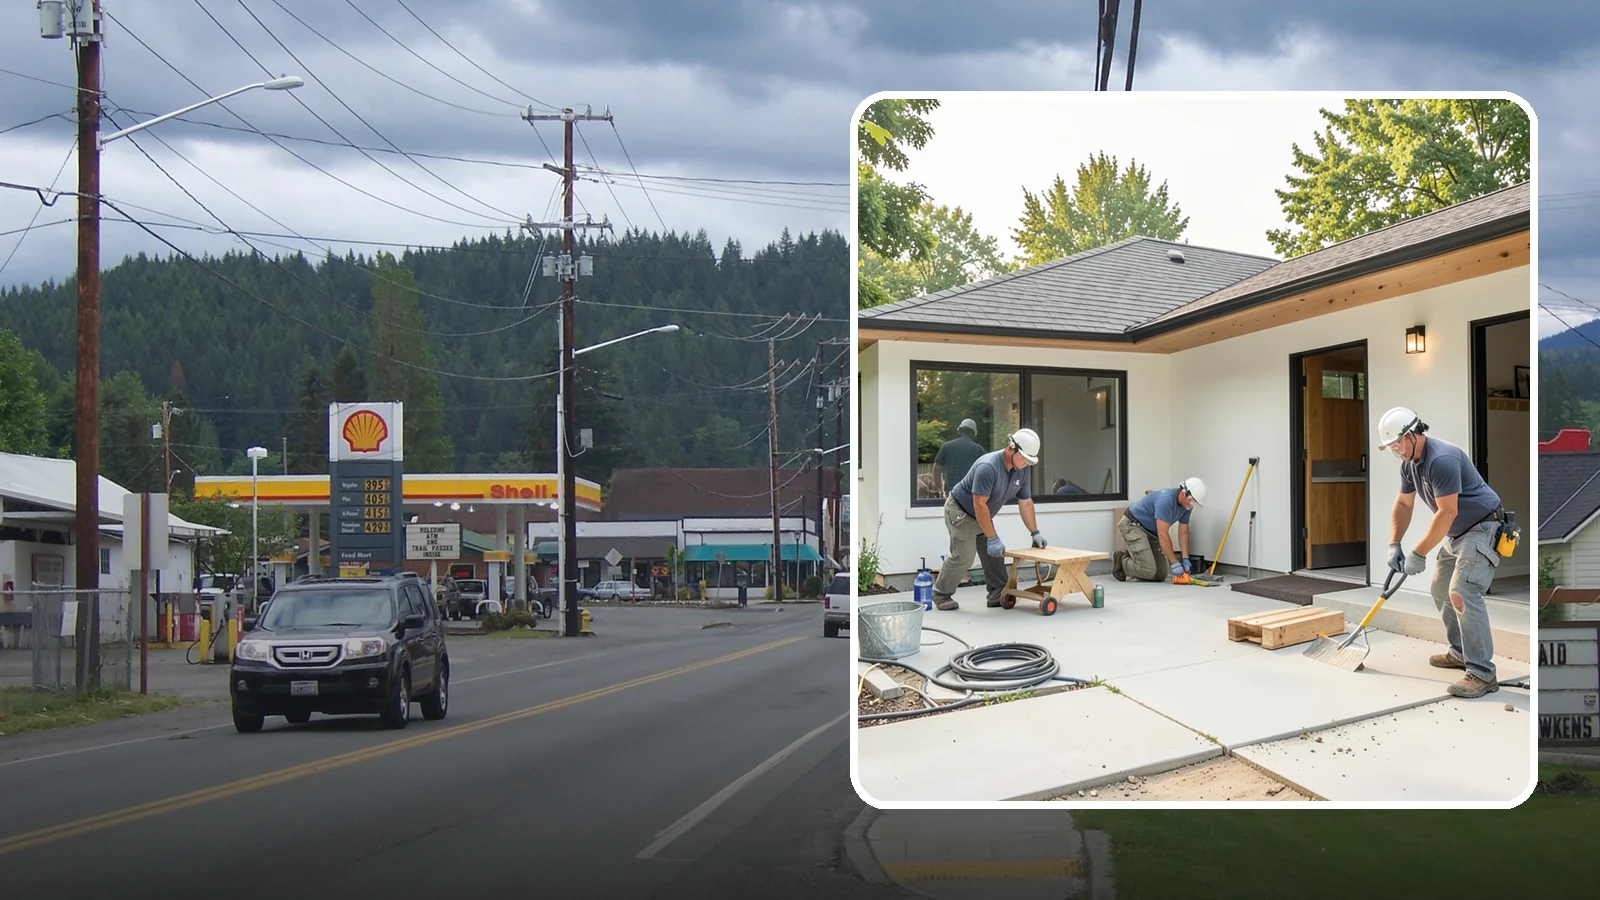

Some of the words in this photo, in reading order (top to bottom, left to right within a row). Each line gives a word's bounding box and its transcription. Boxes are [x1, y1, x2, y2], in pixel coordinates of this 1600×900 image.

[366, 480, 383, 490] 395
[490, 484, 547, 499] Shell
[366, 494, 383, 504] 405
[366, 508, 383, 518] 415
[366, 522, 383, 532] 429
[1538, 643, 1566, 665] AID
